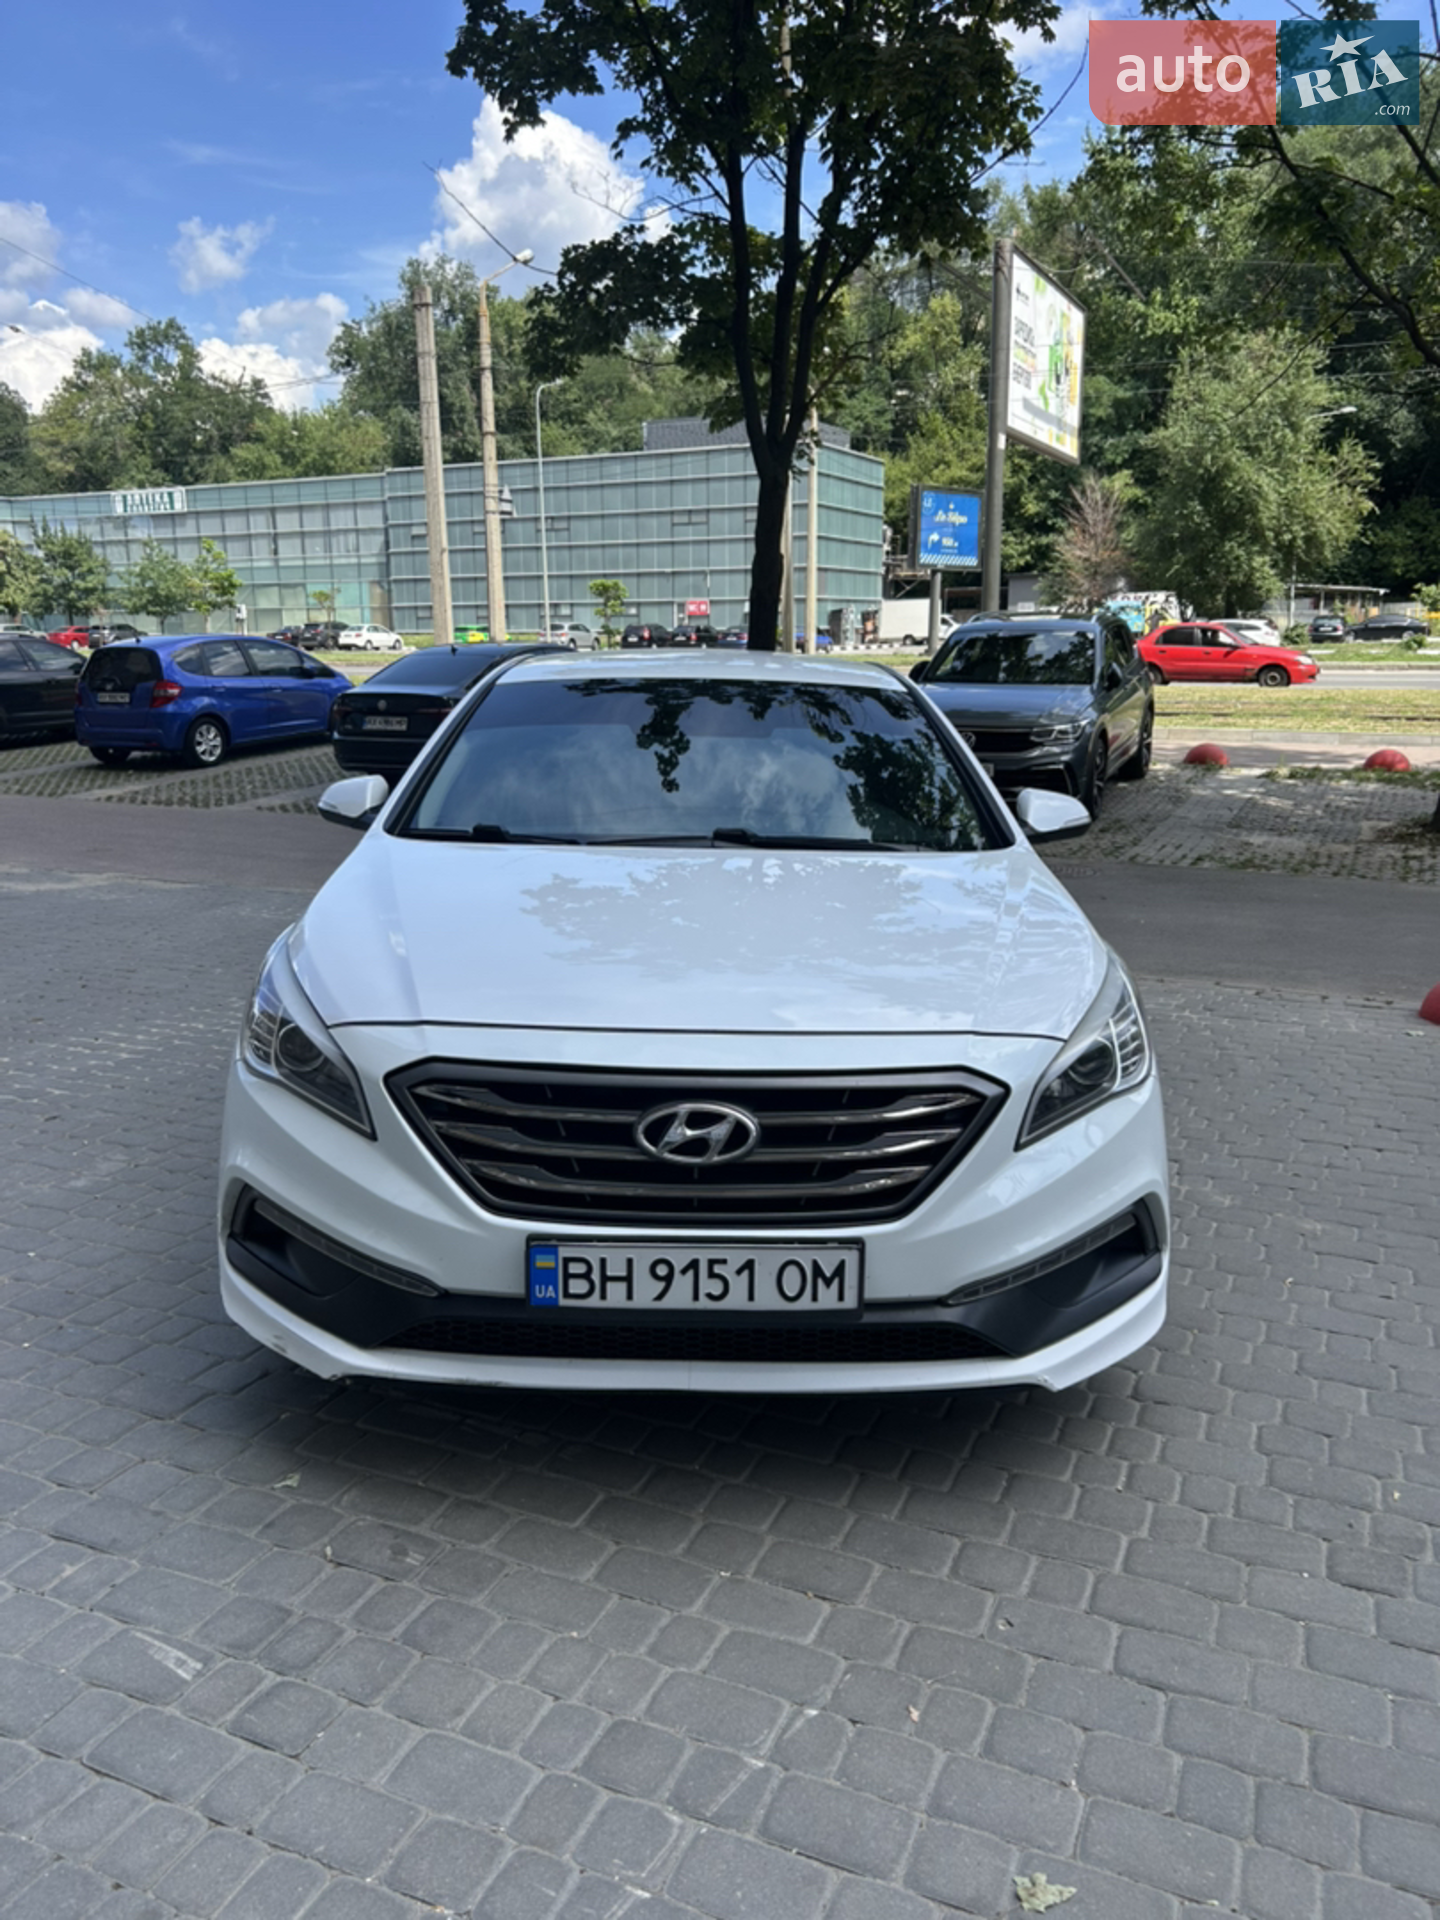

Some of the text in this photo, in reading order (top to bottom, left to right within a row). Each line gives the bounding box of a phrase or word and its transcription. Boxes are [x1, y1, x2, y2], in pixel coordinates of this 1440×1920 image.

[535, 1284, 556, 1299] UA
[562, 1256, 846, 1303] BH 9151 OM
